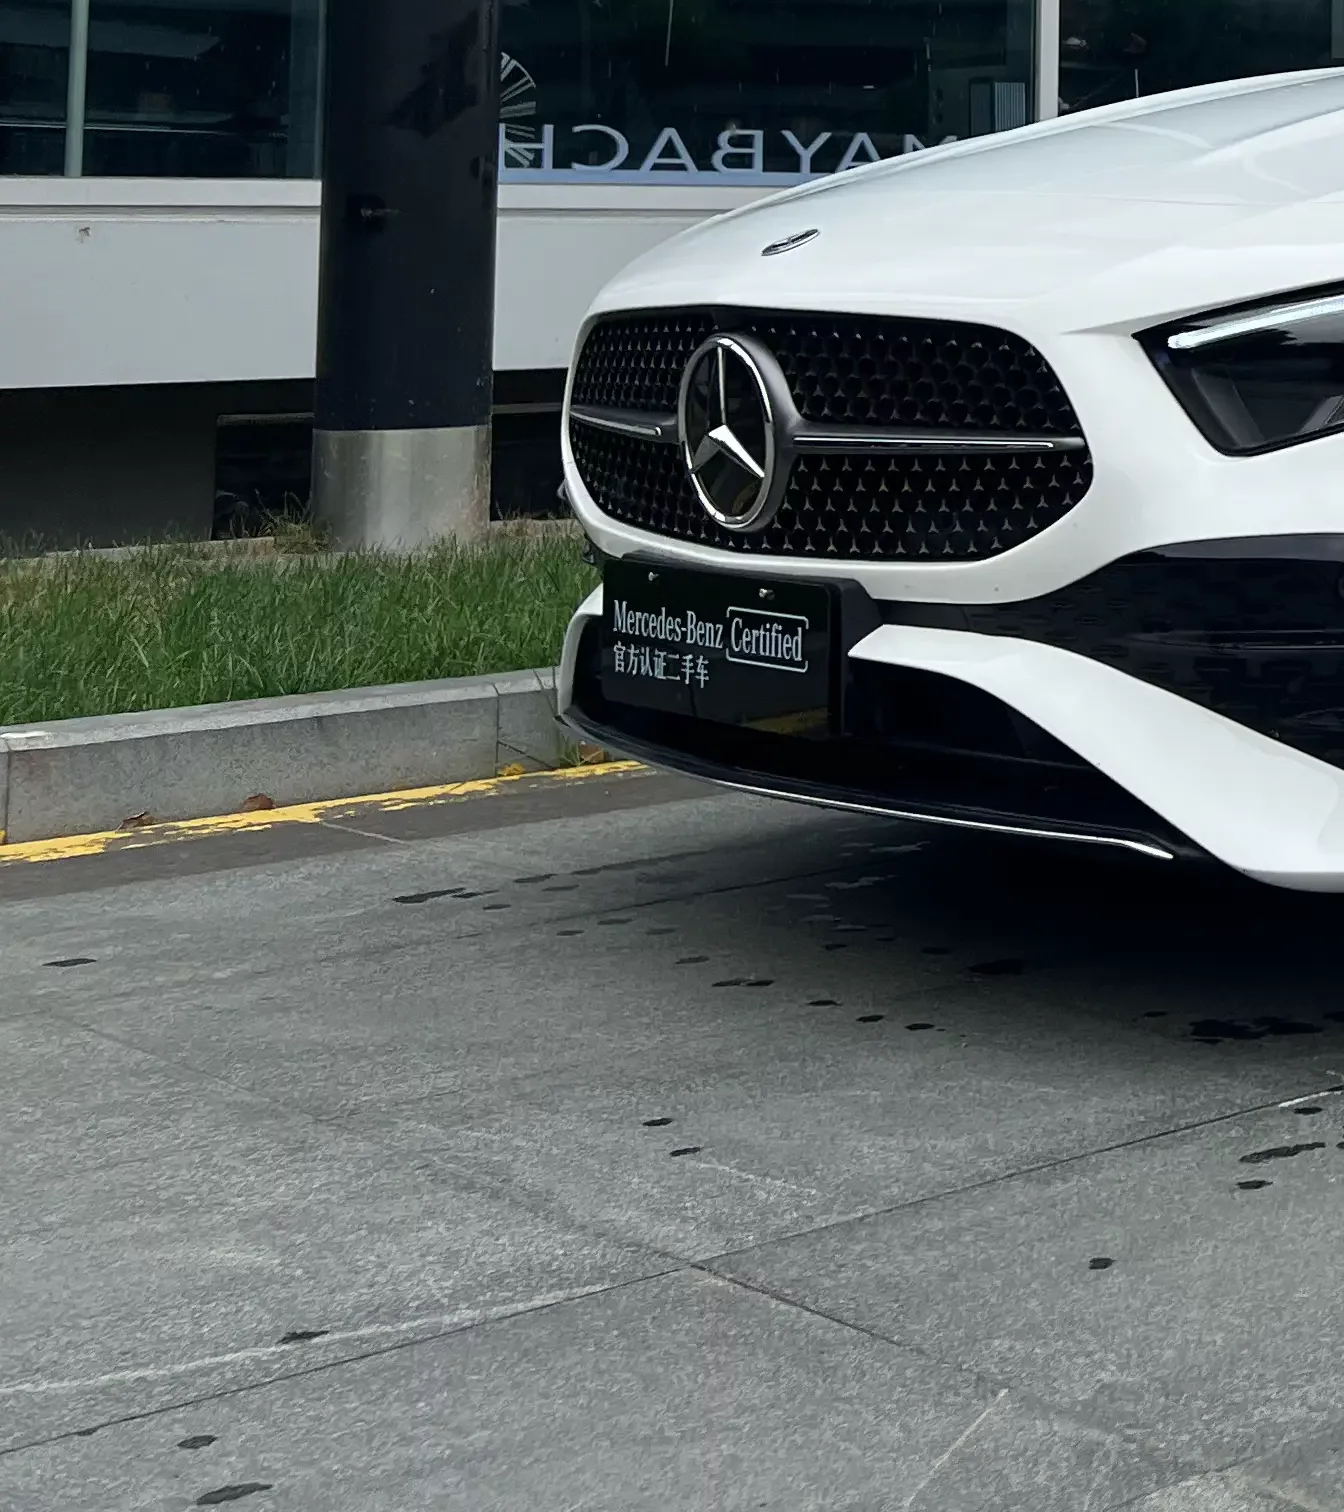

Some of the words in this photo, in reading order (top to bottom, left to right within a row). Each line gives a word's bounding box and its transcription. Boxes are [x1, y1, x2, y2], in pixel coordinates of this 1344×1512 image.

[613, 600, 724, 649] Mercedes-Benz
[731, 616, 802, 661] Certified
[613, 640, 709, 688] 官方认证二手车
